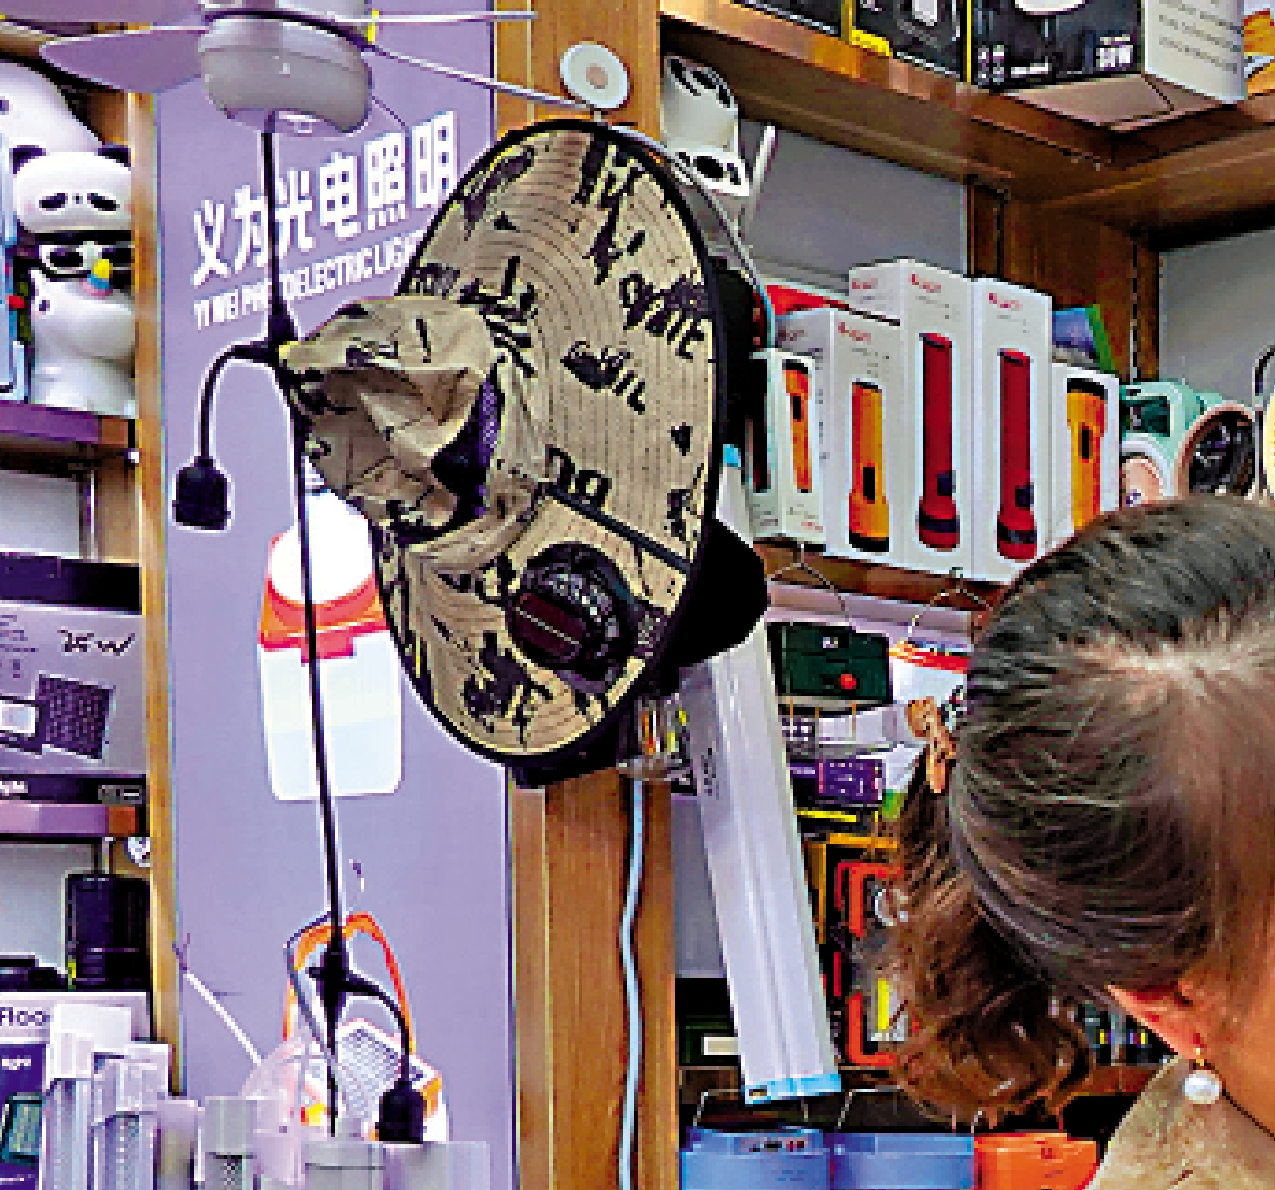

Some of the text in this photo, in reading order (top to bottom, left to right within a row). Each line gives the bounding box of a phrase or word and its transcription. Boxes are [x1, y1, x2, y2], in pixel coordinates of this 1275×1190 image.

[191, 110, 457, 287] 义为光电照明
